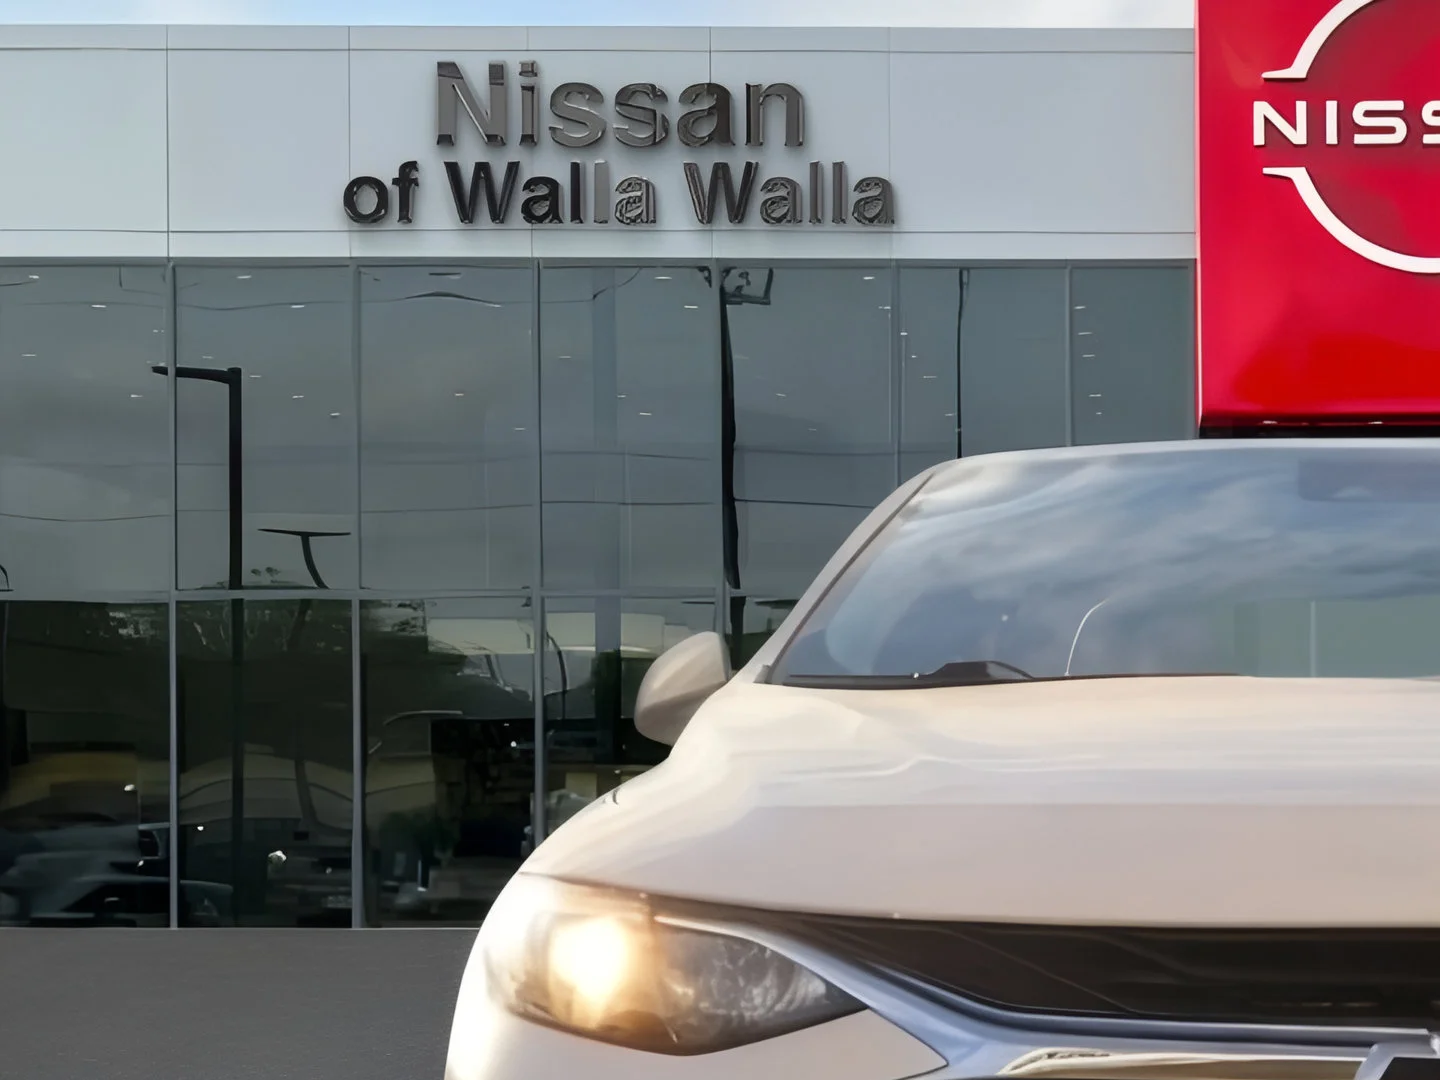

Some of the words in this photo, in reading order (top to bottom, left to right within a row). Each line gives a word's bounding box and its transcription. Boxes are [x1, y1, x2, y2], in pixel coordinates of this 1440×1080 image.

[436, 61, 806, 147] Nissan
[343, 161, 420, 224] of
[444, 161, 657, 225] Walla
[684, 161, 895, 226] Walla
